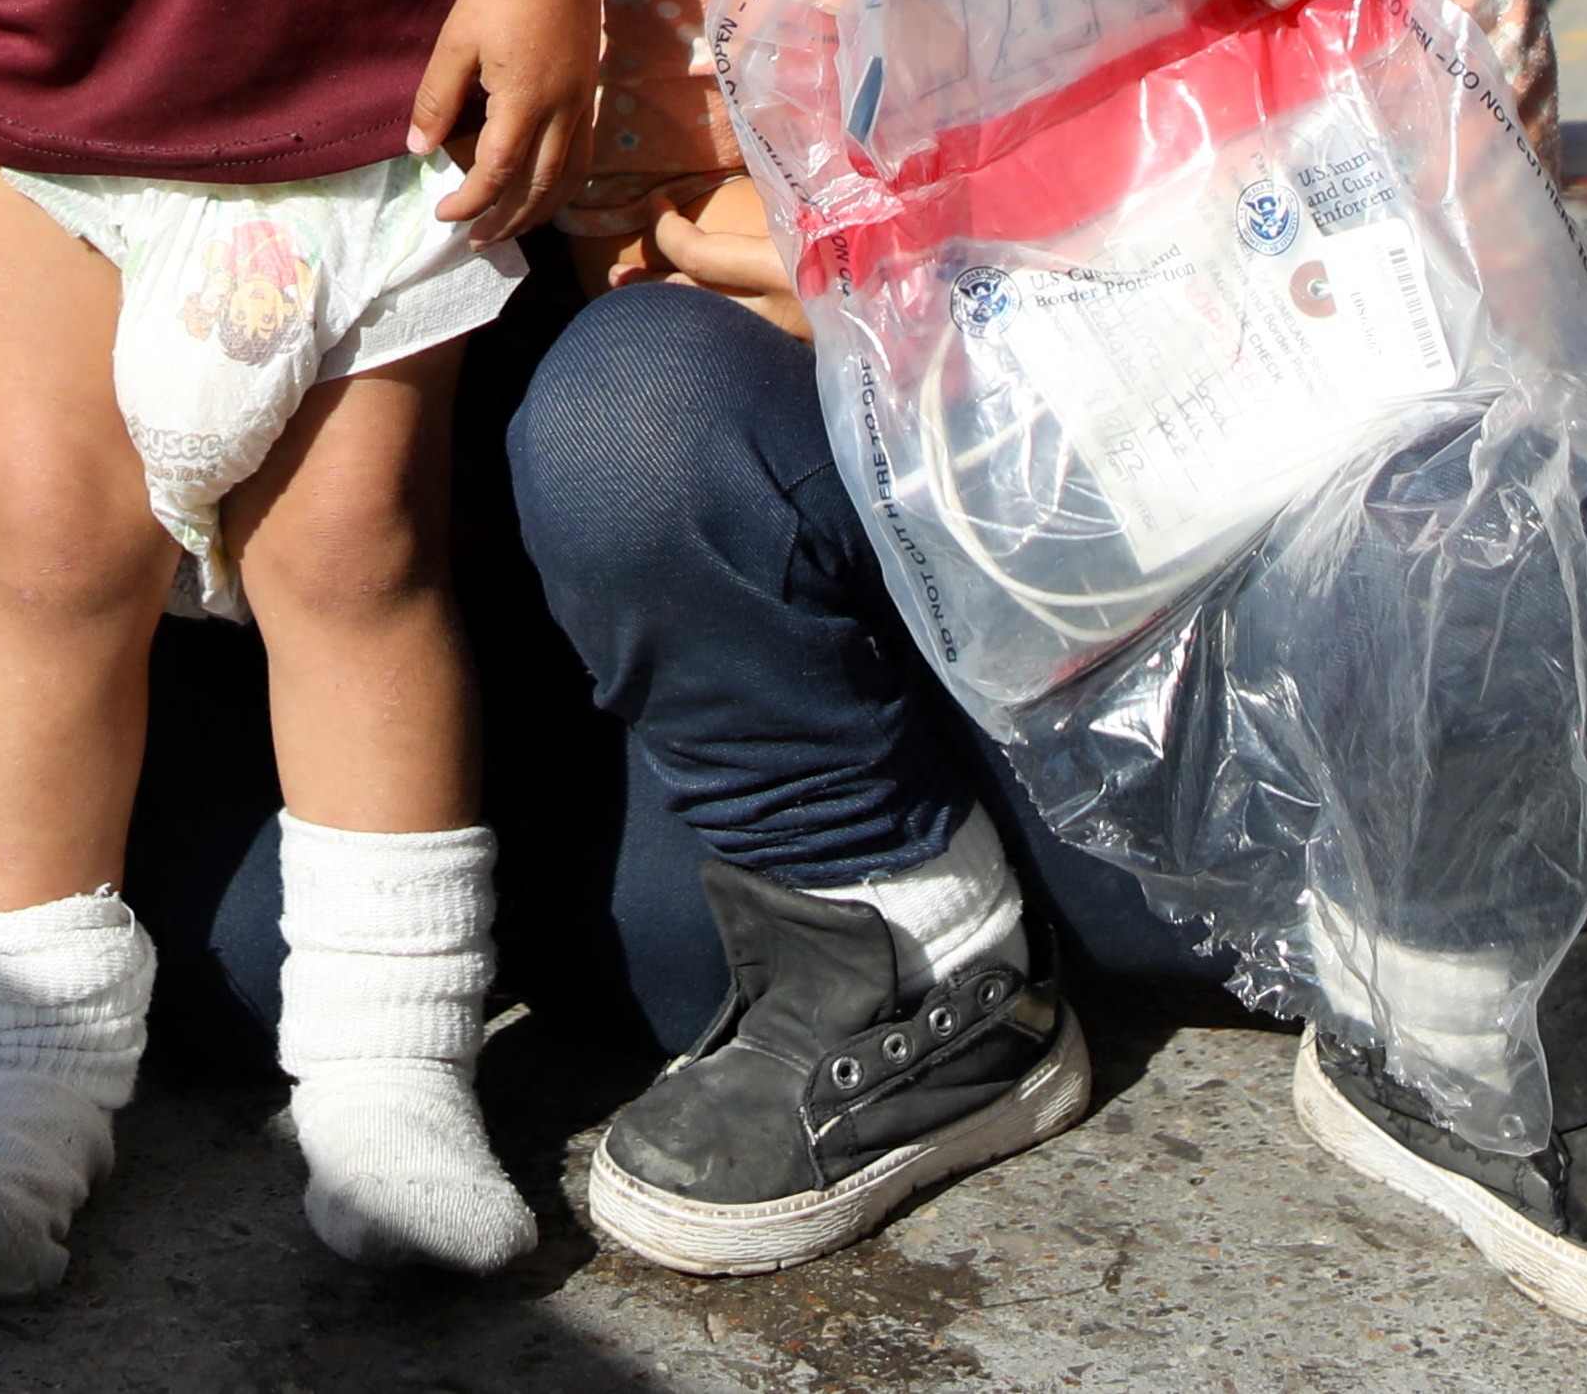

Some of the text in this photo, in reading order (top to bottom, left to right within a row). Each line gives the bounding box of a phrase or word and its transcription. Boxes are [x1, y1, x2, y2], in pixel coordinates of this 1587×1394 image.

[1446, 58, 1480, 90] DO
[1480, 91, 1514, 133] NOT
[1297, 165, 1331, 187] U.S.
[1306, 186, 1339, 208] and
[828, 229, 852, 264] NO
[1035, 286, 1098, 309] Border
[1246, 332, 1286, 386] CHECK
[863, 414, 883, 445] TO
[874, 453, 900, 518] HERE
[893, 524, 925, 566] CUT
[920, 573, 948, 624] NOT
[941, 627, 958, 664] DO
